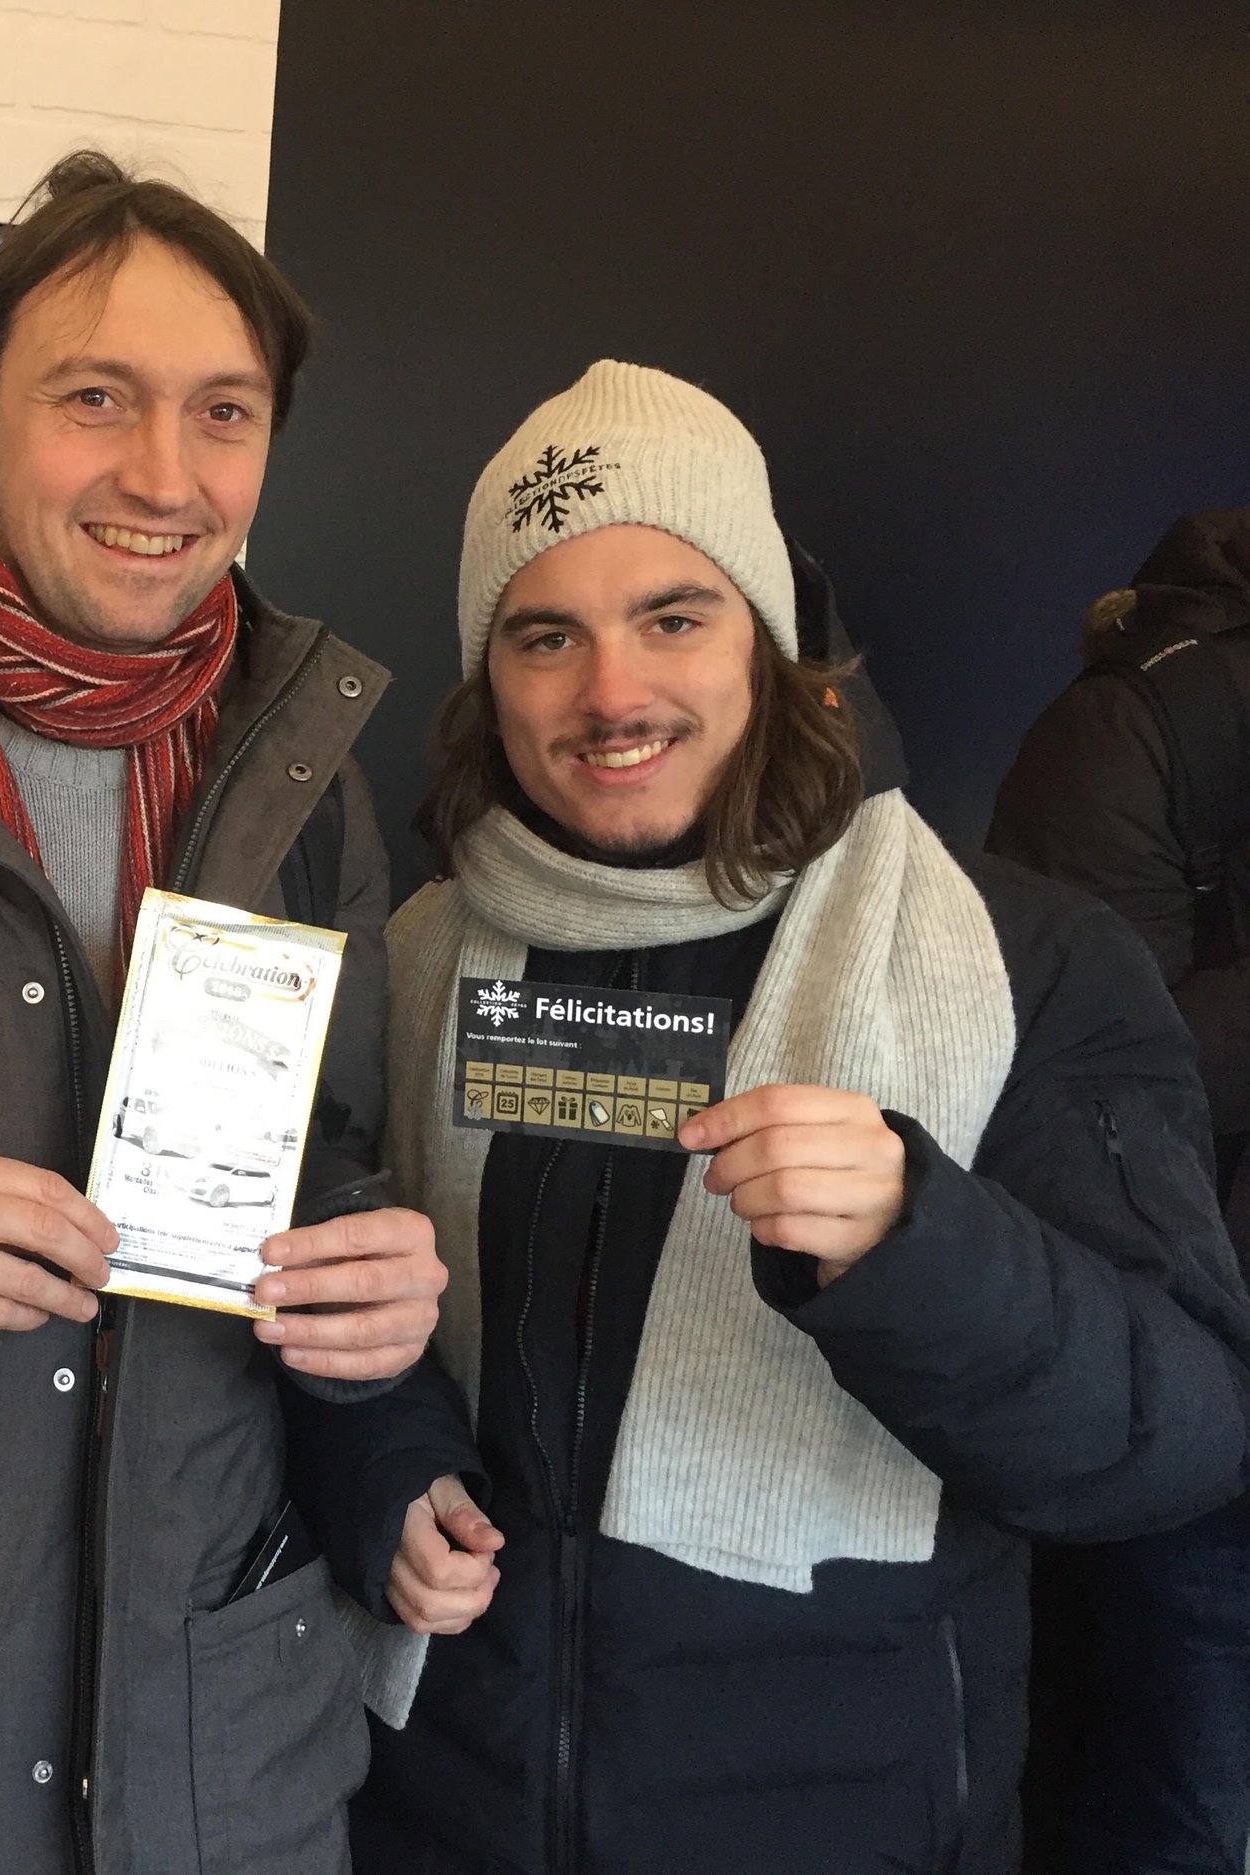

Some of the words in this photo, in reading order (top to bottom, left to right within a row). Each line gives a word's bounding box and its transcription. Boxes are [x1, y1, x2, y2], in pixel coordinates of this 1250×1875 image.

[535, 997, 715, 1035] Félicitations!
[466, 1031, 485, 1040] Vous
[486, 1034, 526, 1044] remportez
[536, 1037, 547, 1046] lot
[548, 1040, 578, 1049] suivant
[500, 1098, 515, 1109] 25
